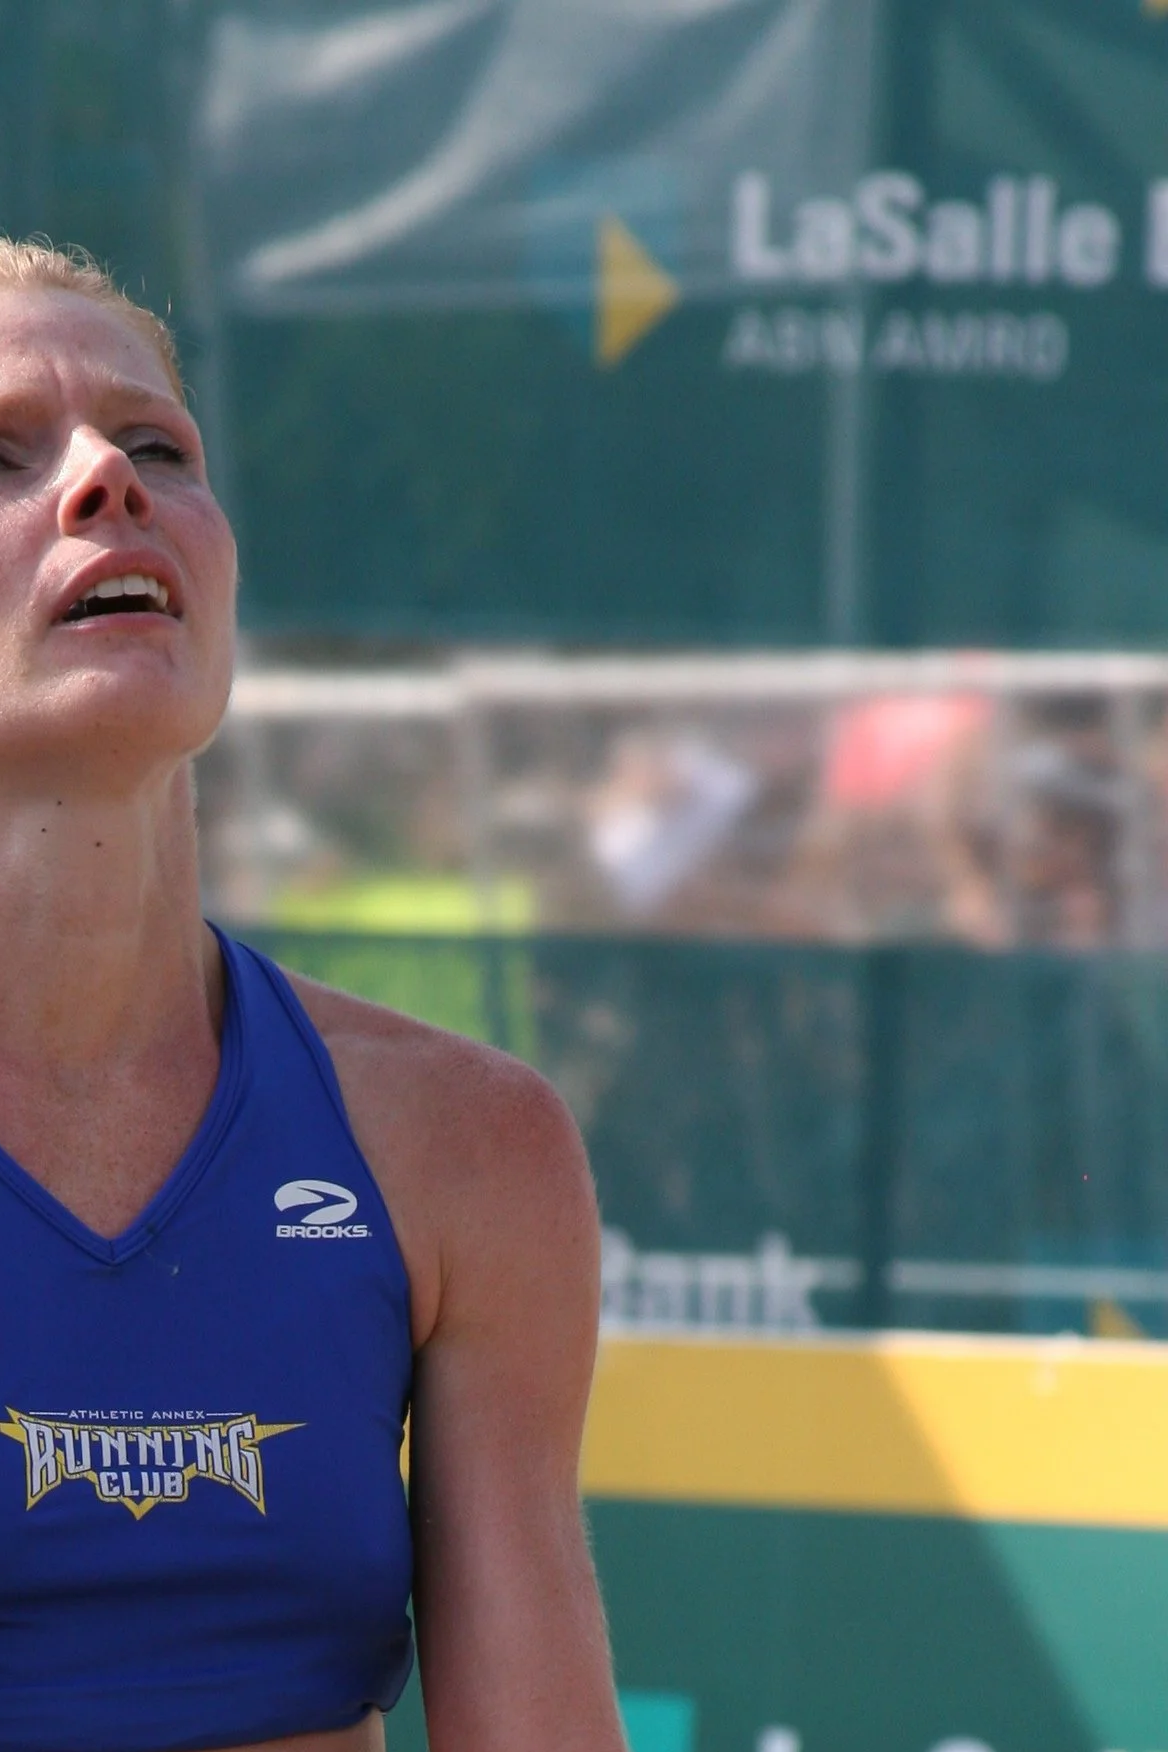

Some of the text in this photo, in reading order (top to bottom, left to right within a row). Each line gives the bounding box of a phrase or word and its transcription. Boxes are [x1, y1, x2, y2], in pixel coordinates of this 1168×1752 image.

[730, 170, 1121, 288] LaSalle
[870, 310, 1071, 382] AMRO
[275, 1225, 368, 1238] BROOKS
[68, 1409, 206, 1421] ATHLETIC ANNEX
[19, 1418, 260, 1502] RUNNING
[98, 1470, 185, 1498] CLUB
